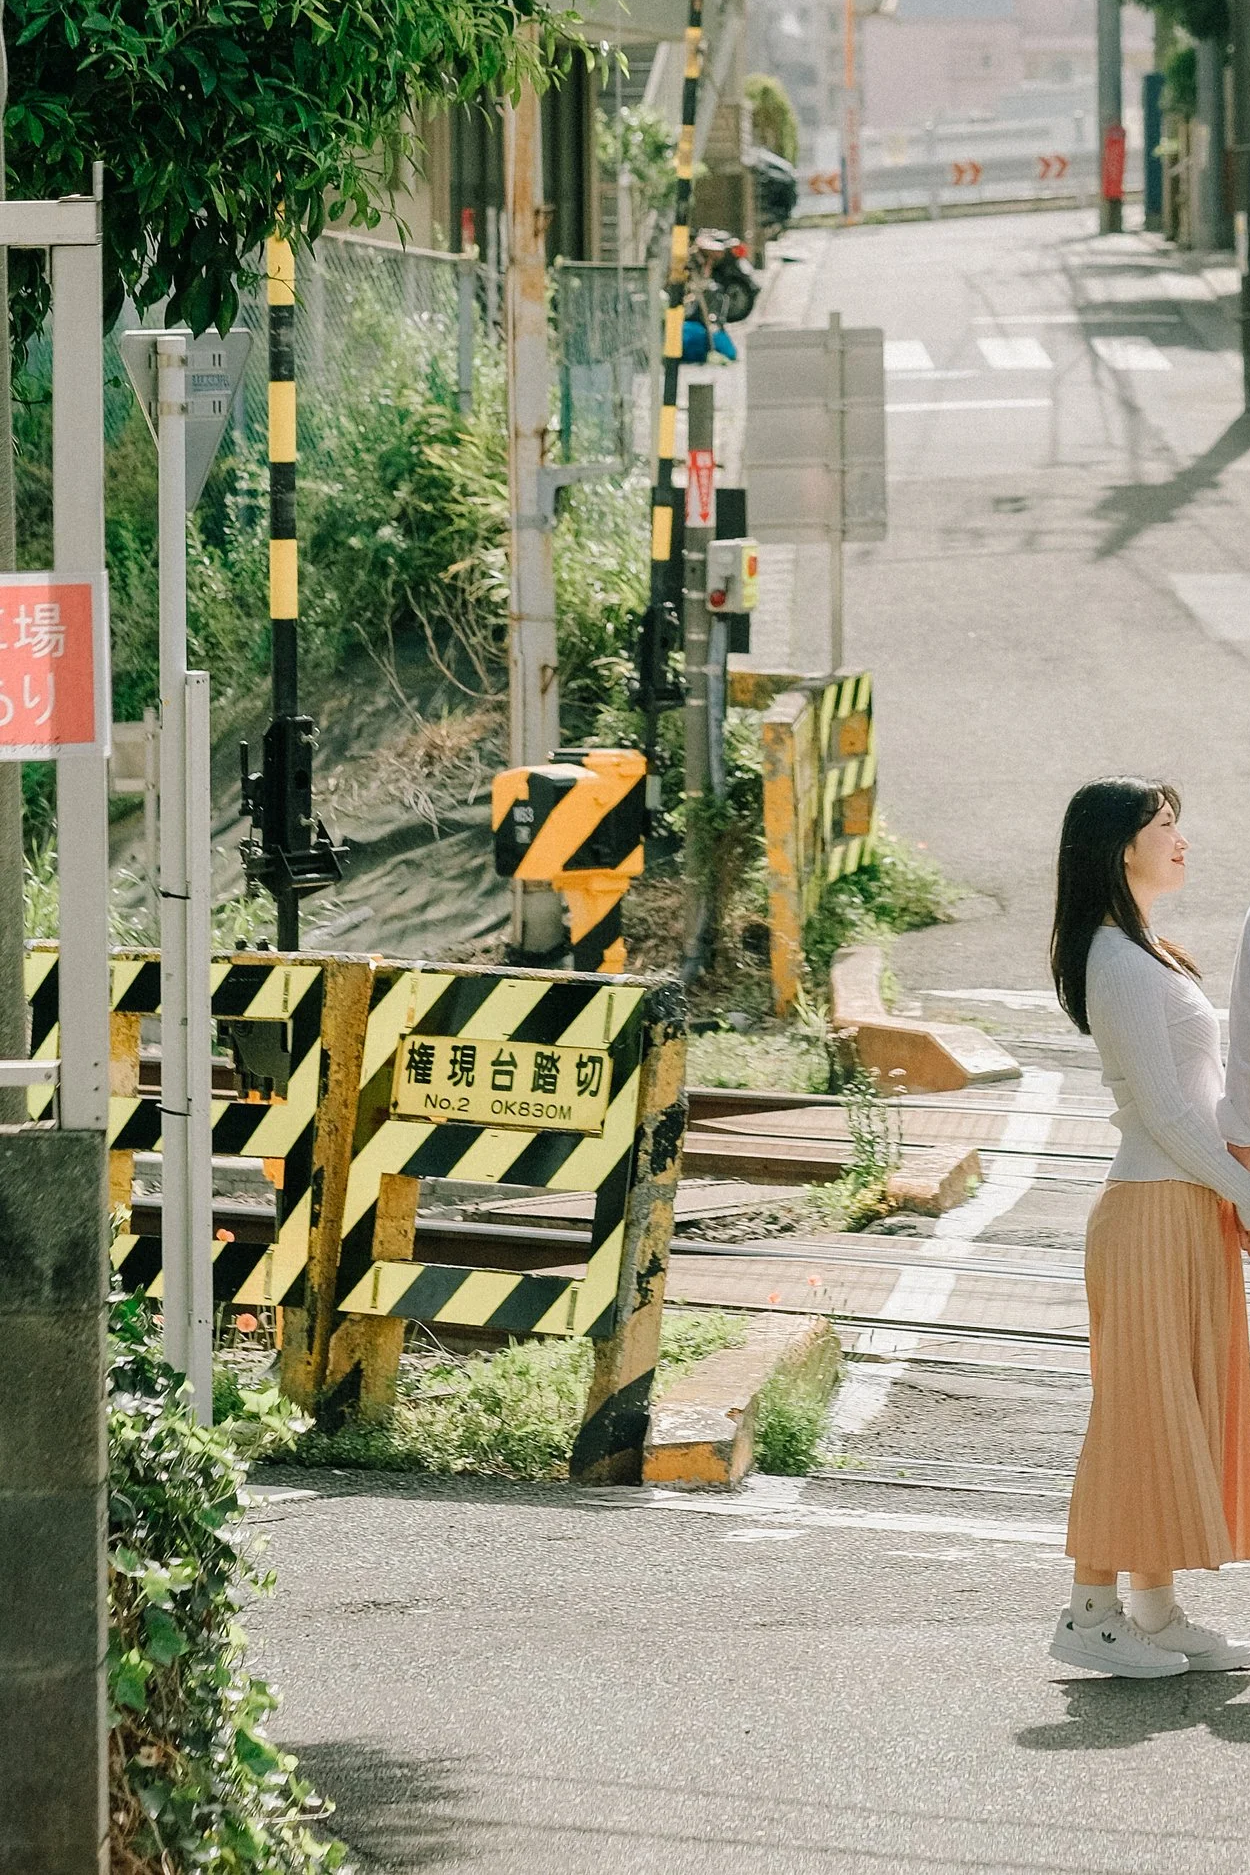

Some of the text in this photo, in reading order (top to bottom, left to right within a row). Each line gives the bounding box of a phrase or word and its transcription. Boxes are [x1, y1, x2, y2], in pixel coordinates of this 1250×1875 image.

[0, 603, 68, 659] 場
[406, 1040, 604, 1098] 権現台踏切
[424, 1093, 470, 1113] No.2
